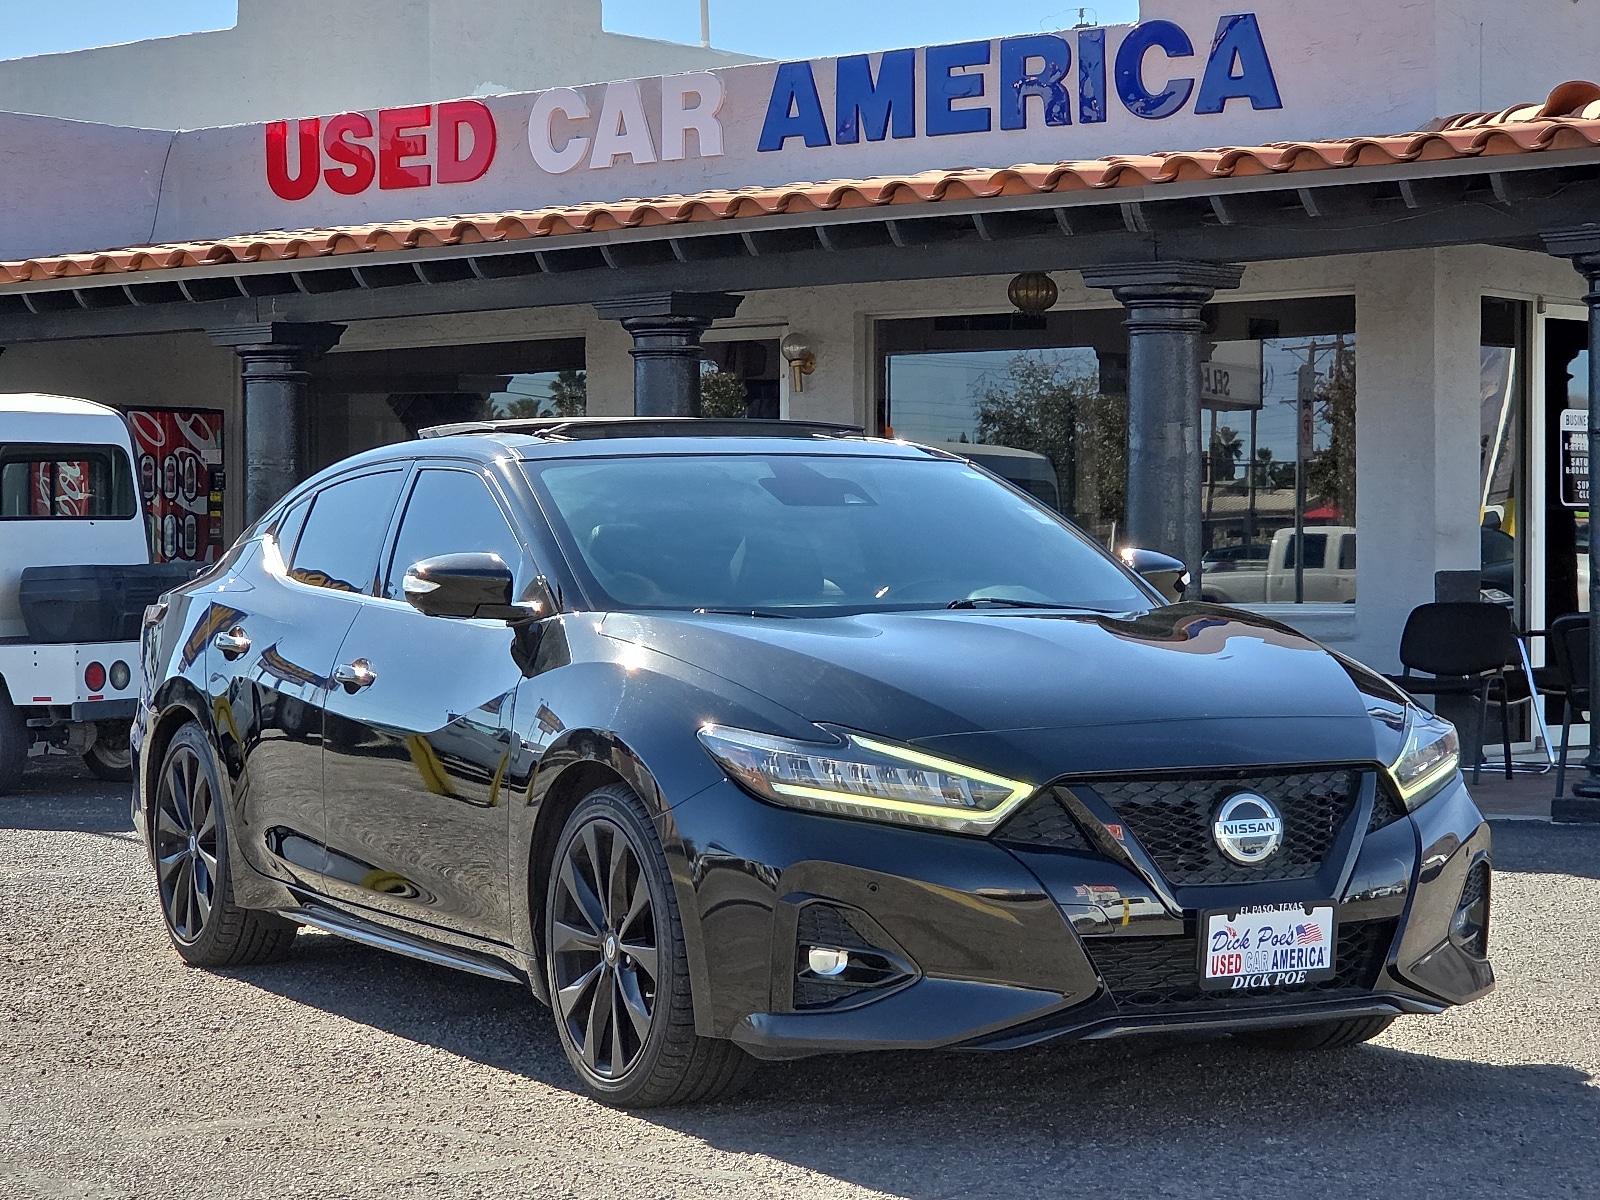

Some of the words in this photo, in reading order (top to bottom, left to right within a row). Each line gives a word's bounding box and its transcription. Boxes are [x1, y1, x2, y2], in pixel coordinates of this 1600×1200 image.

[265, 99, 497, 201] USED
[527, 72, 726, 175] CAR
[756, 13, 1284, 153] AMERICA
[1565, 414, 1588, 426] BUSINE
[1223, 821, 1275, 835] NISSAN
[1278, 901, 1304, 912] TEXAS
[1211, 928, 1251, 952] Dick
[1256, 923, 1294, 949] Poe's
[1211, 954, 1242, 975] USED
[1244, 950, 1269, 973] CAR
[1271, 947, 1324, 970] AMERICA
[1231, 973, 1271, 989] DICK
[1273, 970, 1307, 986] POE
